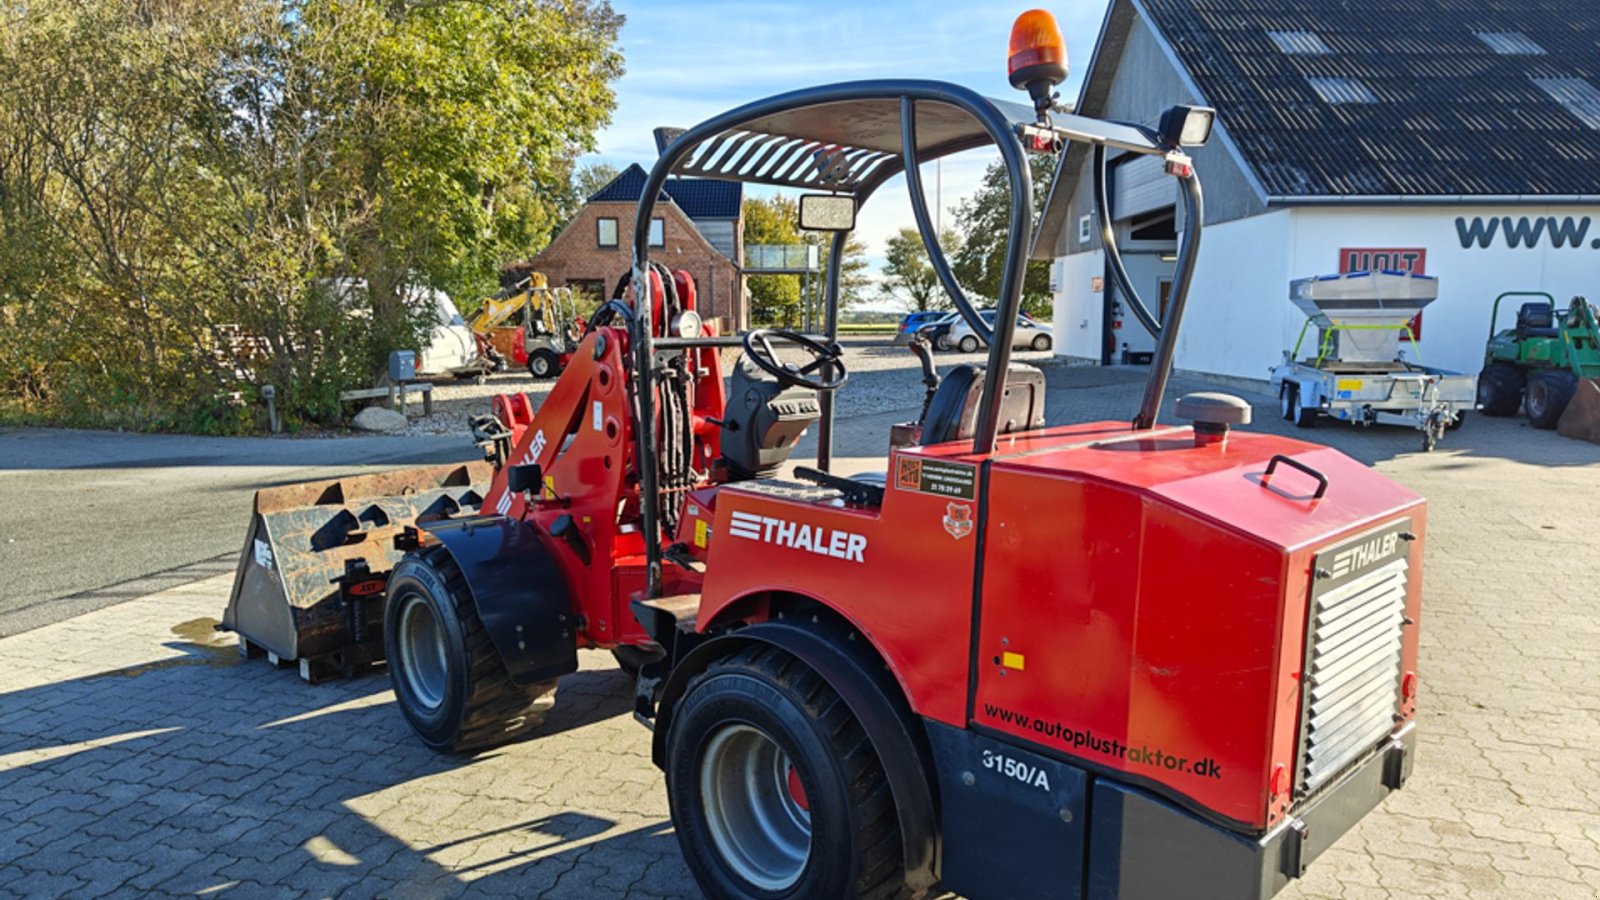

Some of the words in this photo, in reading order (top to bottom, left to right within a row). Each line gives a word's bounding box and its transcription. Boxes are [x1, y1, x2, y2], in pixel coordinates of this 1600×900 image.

[761, 516, 868, 563] THALER
[1350, 531, 1399, 572] THALER
[984, 703, 1222, 780] www.autoplustraktor.dk
[982, 750, 1051, 792] 3150/A
